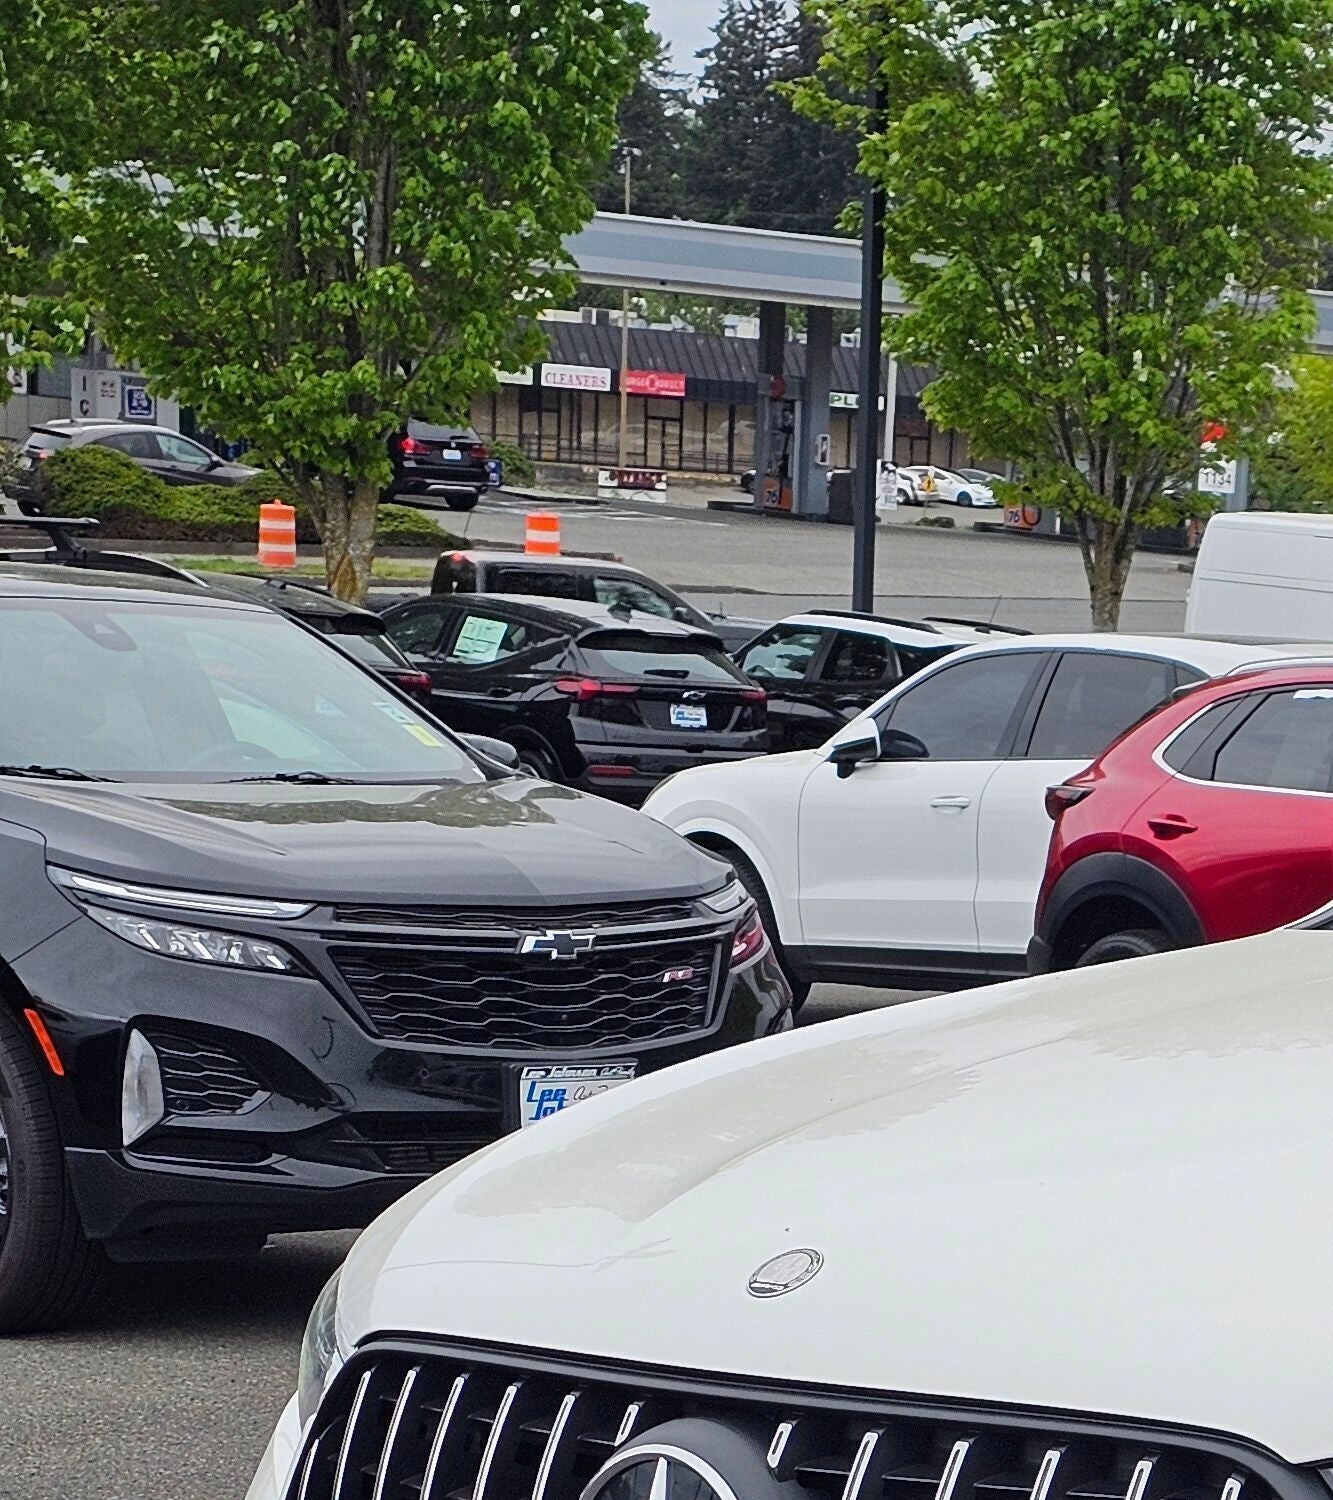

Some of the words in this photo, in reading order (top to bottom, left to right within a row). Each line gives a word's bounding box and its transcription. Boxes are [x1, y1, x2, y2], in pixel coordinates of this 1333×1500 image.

[545, 372, 606, 388] CLEANERS
[1008, 510, 1019, 523] 76
[526, 1081, 567, 1103] Lee
